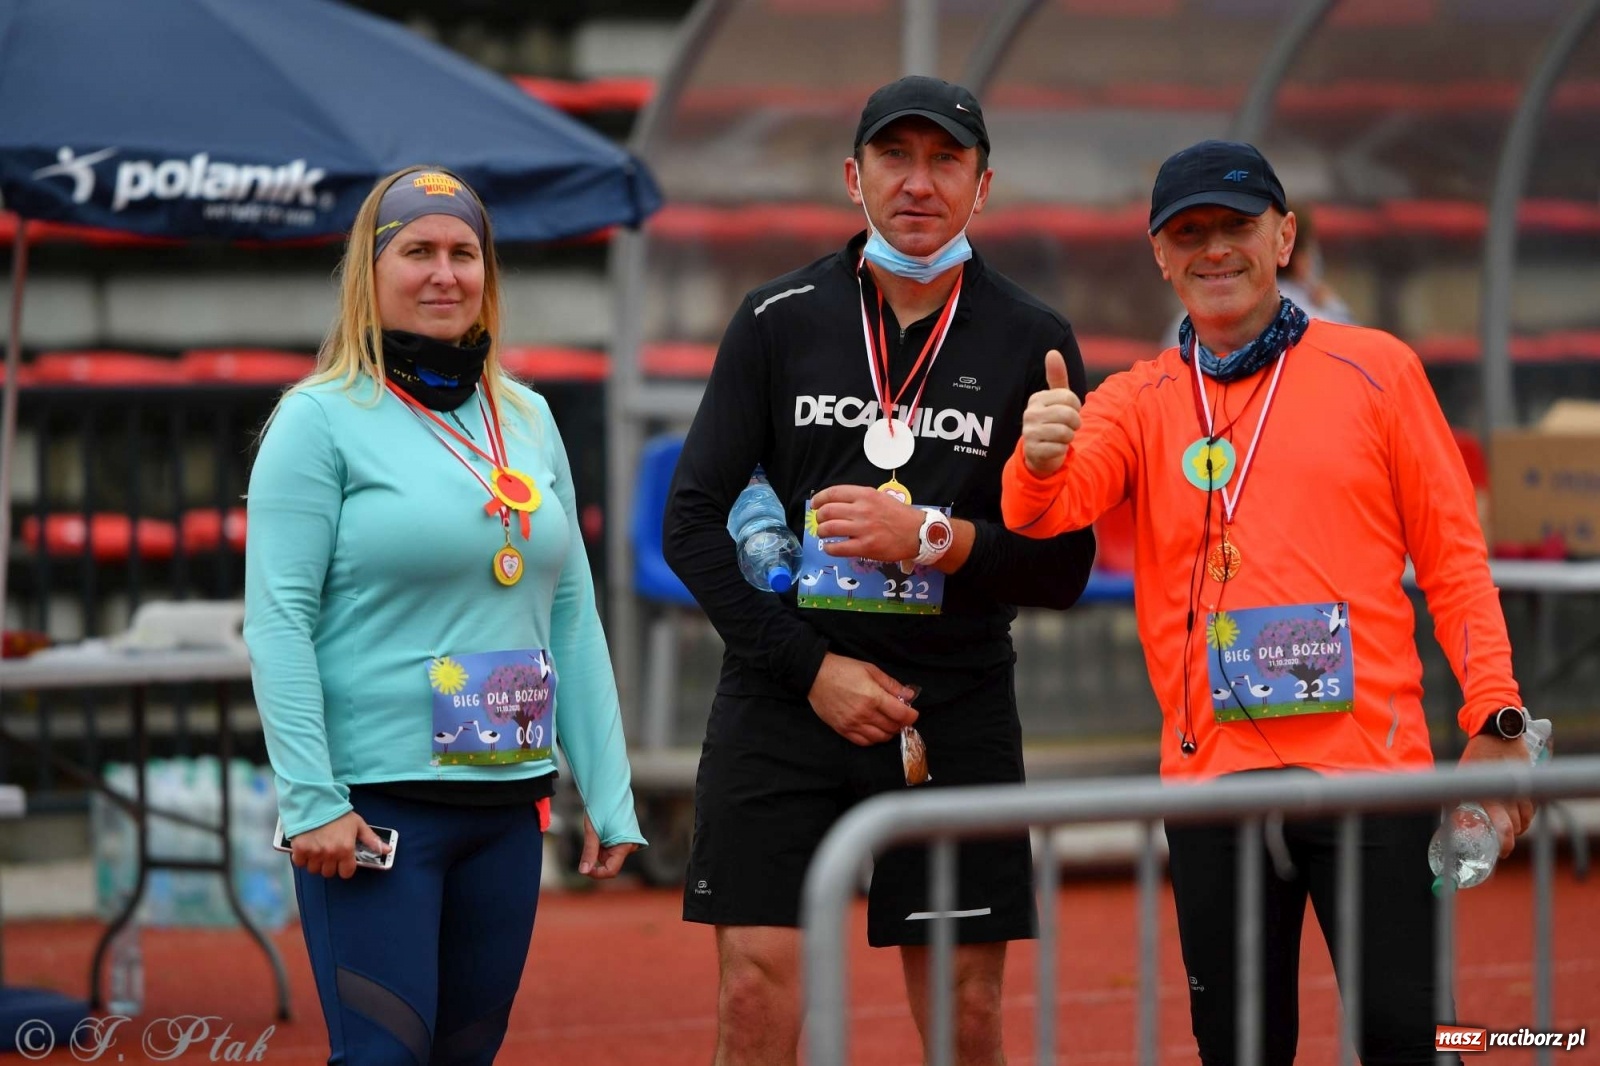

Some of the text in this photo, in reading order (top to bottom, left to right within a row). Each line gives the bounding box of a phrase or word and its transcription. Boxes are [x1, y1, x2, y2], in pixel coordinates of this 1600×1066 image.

[111, 153, 327, 212] polanik
[795, 395, 993, 447] DECAHLON
[953, 444, 988, 458] RYBNIK
[883, 579, 930, 599] 222
[1224, 641, 1342, 663] BIEG DLA BOŻENY
[1269, 658, 1299, 667] 11.10.2020
[453, 687, 549, 708] BIEG DLA BOŻENY
[1294, 678, 1341, 699] 225
[516, 720, 544, 749] 069
